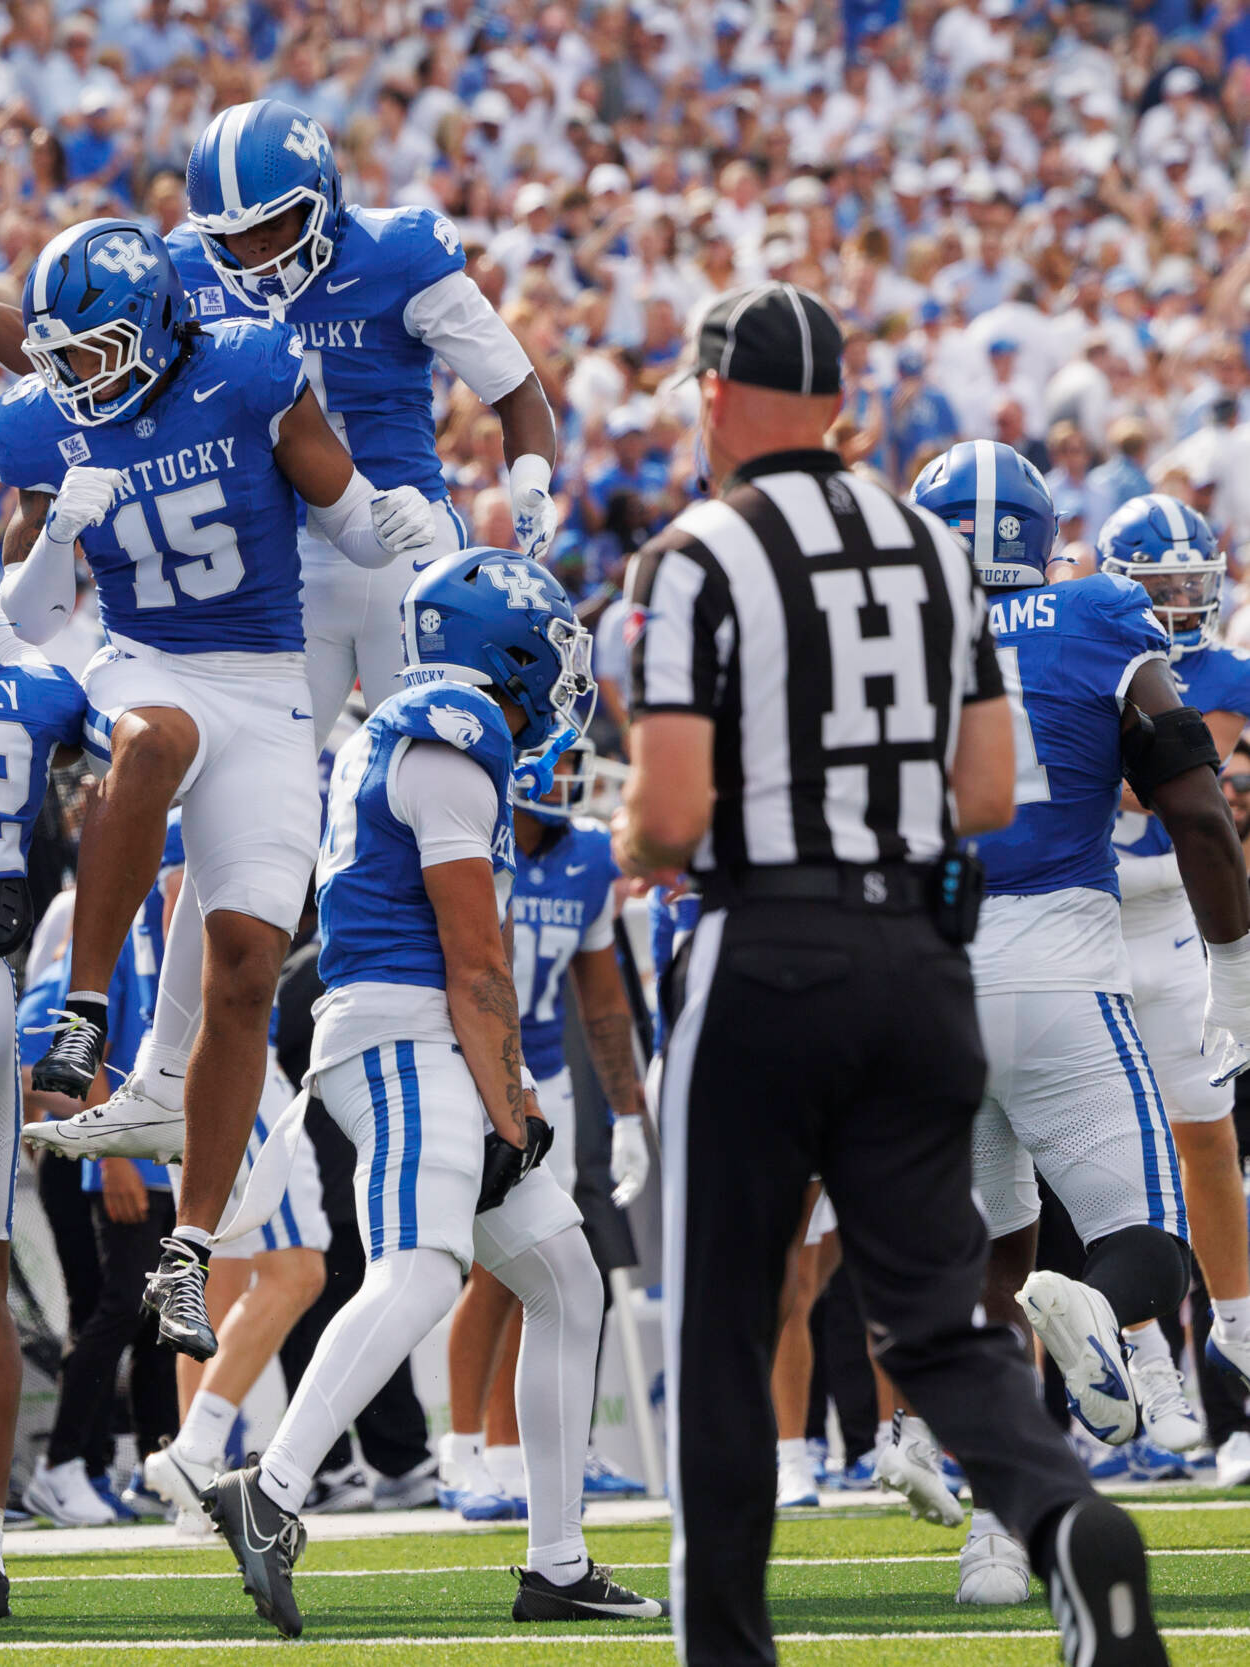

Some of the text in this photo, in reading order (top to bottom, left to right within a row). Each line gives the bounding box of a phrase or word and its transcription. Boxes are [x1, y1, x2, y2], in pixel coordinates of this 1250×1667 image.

[90, 236, 158, 284] UK
[136, 418, 156, 438] SEC
[113, 478, 246, 609] 15
[999, 517, 1020, 539] SEC
[482, 563, 552, 611] UK
[421, 610, 441, 632] SEC
[810, 565, 937, 750] H
